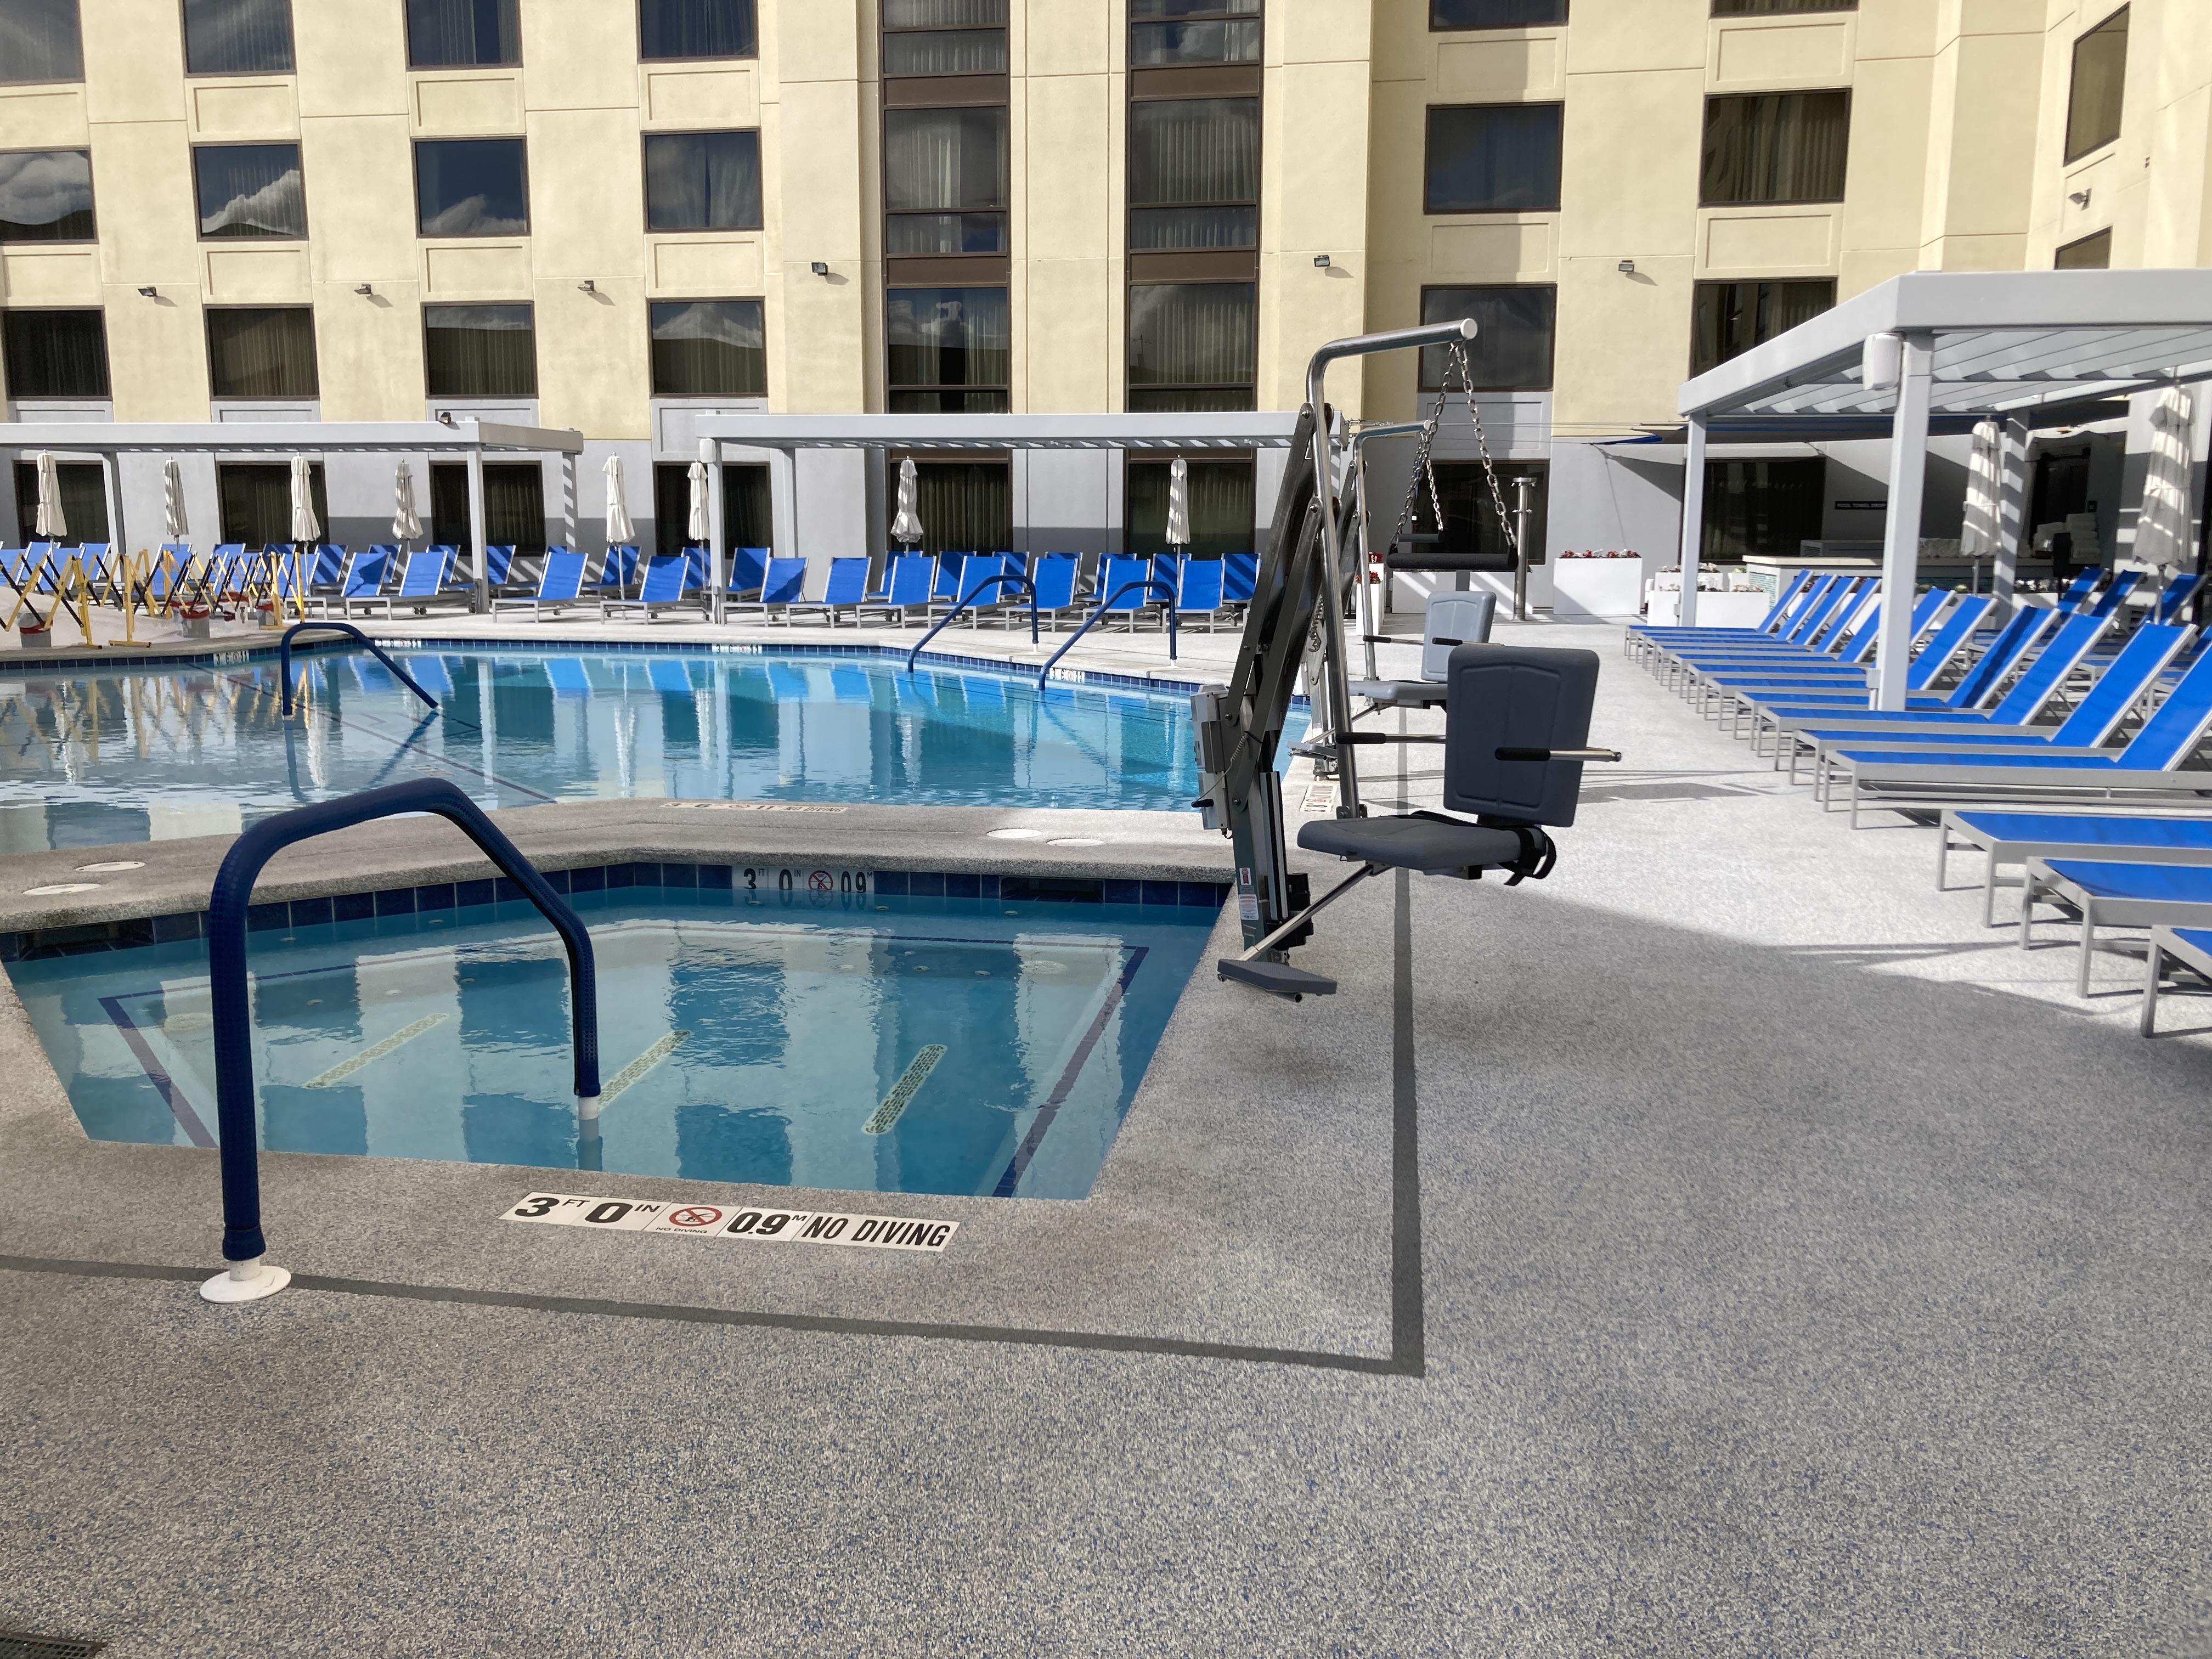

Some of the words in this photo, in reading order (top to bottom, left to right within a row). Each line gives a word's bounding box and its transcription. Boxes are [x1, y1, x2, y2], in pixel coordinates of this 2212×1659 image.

[743, 868, 757, 889] 3
[779, 869, 793, 890] 0
[794, 868, 801, 877] IN
[515, 1197, 560, 1217] 3
[584, 1203, 633, 1223] 0
[634, 1204, 661, 1212] IN
[726, 1212, 791, 1234] 0.9
[800, 1216, 849, 1239] NO
[850, 1219, 951, 1246] DIVING
